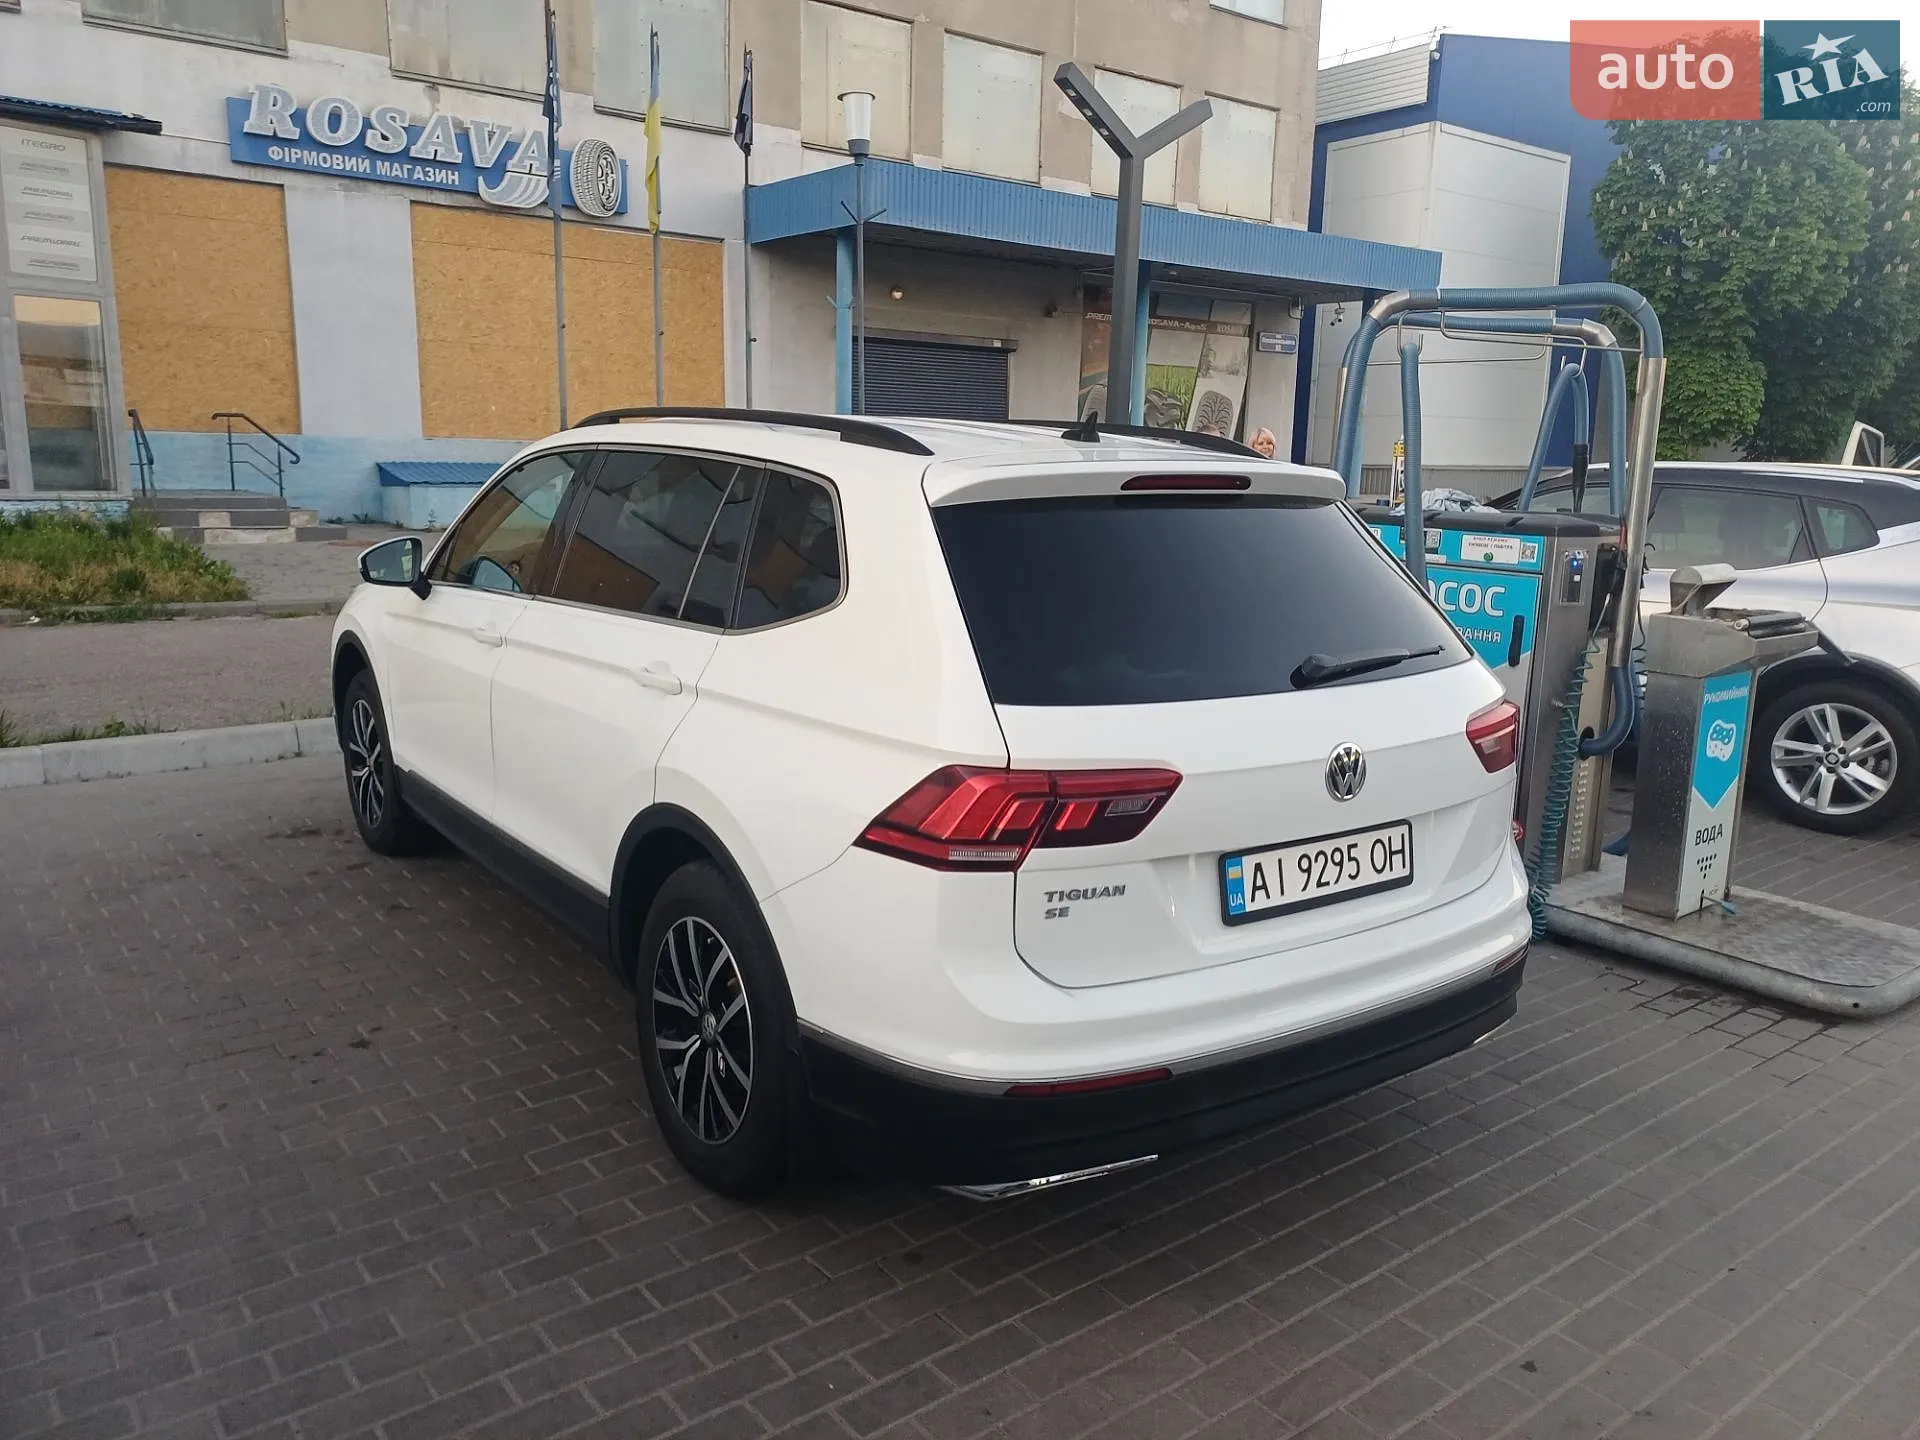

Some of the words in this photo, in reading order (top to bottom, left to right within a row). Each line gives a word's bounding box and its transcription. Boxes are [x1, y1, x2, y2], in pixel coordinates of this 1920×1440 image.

[243, 83, 549, 176] ROSAVA
[267, 145, 371, 174] ФІРМОВИЙ
[376, 159, 460, 186] МАГАЗИН
[1694, 823, 1723, 846] ВОДА
[1250, 864, 1285, 903] AI
[1298, 843, 1361, 892] 9295
[1370, 833, 1407, 875] OH
[1044, 884, 1126, 903] TIGUAN
[1230, 893, 1243, 907] UA
[1044, 907, 1070, 920] SE
